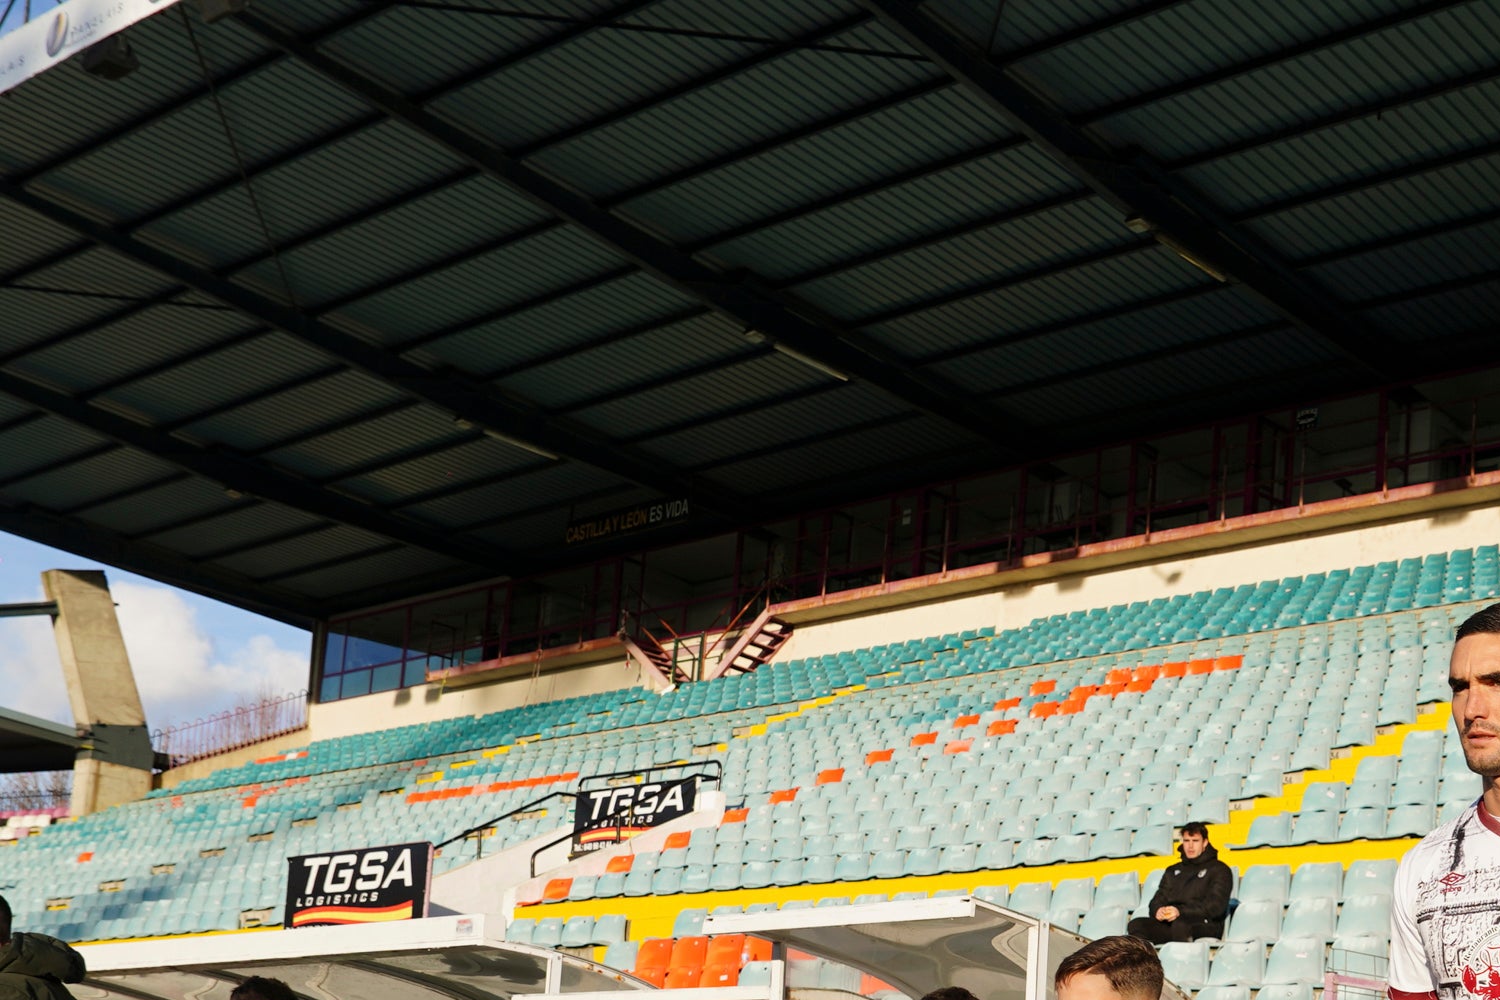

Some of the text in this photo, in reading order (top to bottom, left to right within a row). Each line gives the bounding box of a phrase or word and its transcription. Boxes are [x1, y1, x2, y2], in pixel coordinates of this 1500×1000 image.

[566, 518, 611, 543] CASTILLA
[649, 504, 663, 523] ES
[665, 498, 689, 519] VIDA
[589, 784, 684, 820] TGSA
[303, 848, 413, 895] TGSA
[296, 892, 379, 907] LOGISTICS
[1463, 926, 1498, 962] Restaurante
